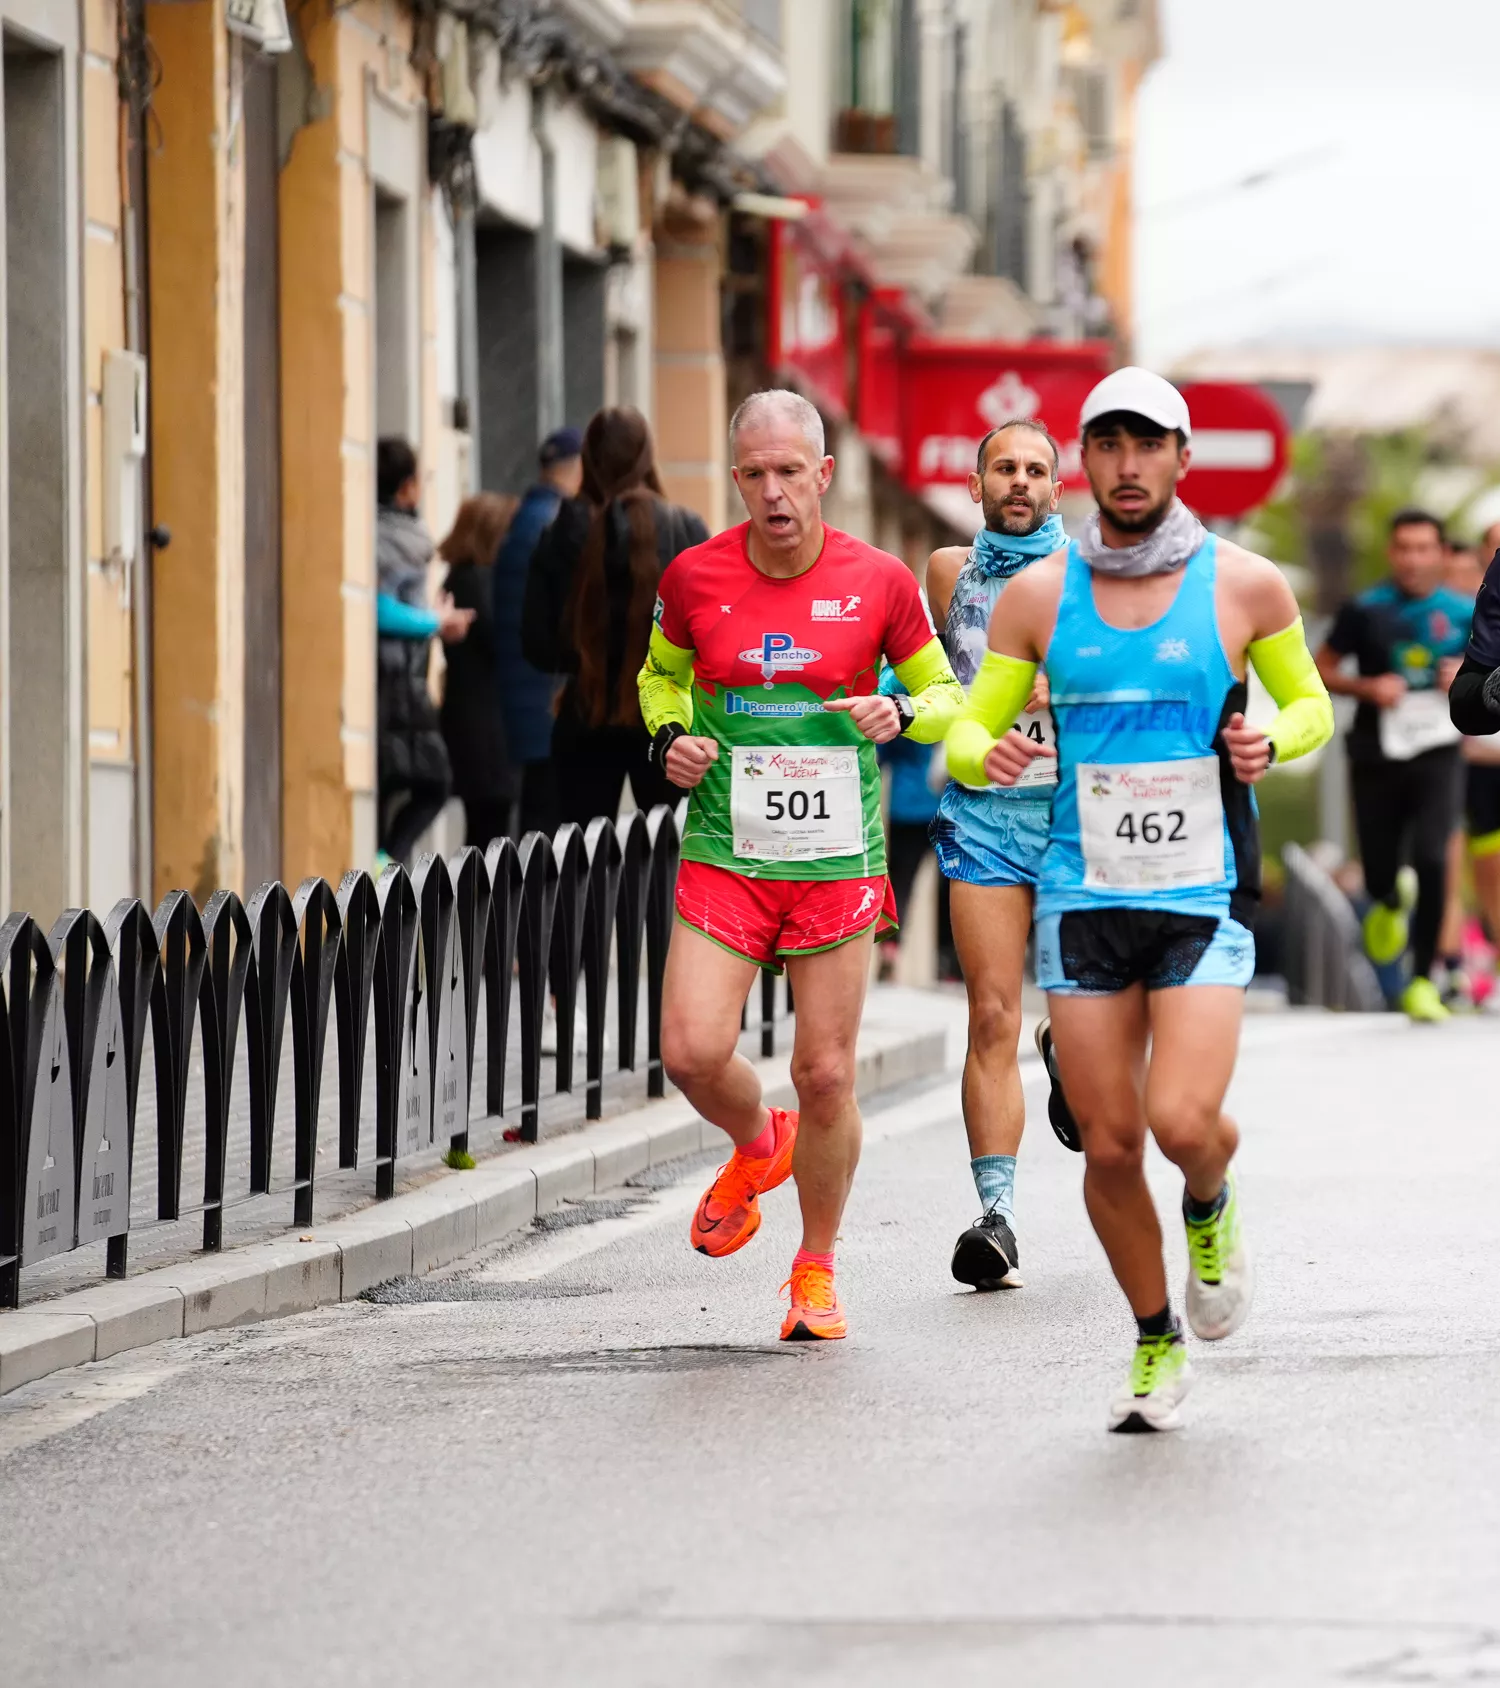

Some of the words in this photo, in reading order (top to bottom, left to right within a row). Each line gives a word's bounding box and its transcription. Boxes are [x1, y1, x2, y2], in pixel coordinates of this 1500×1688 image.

[1013, 720, 1046, 744] 4
[766, 790, 830, 820] 501
[1116, 809, 1188, 844] 462
